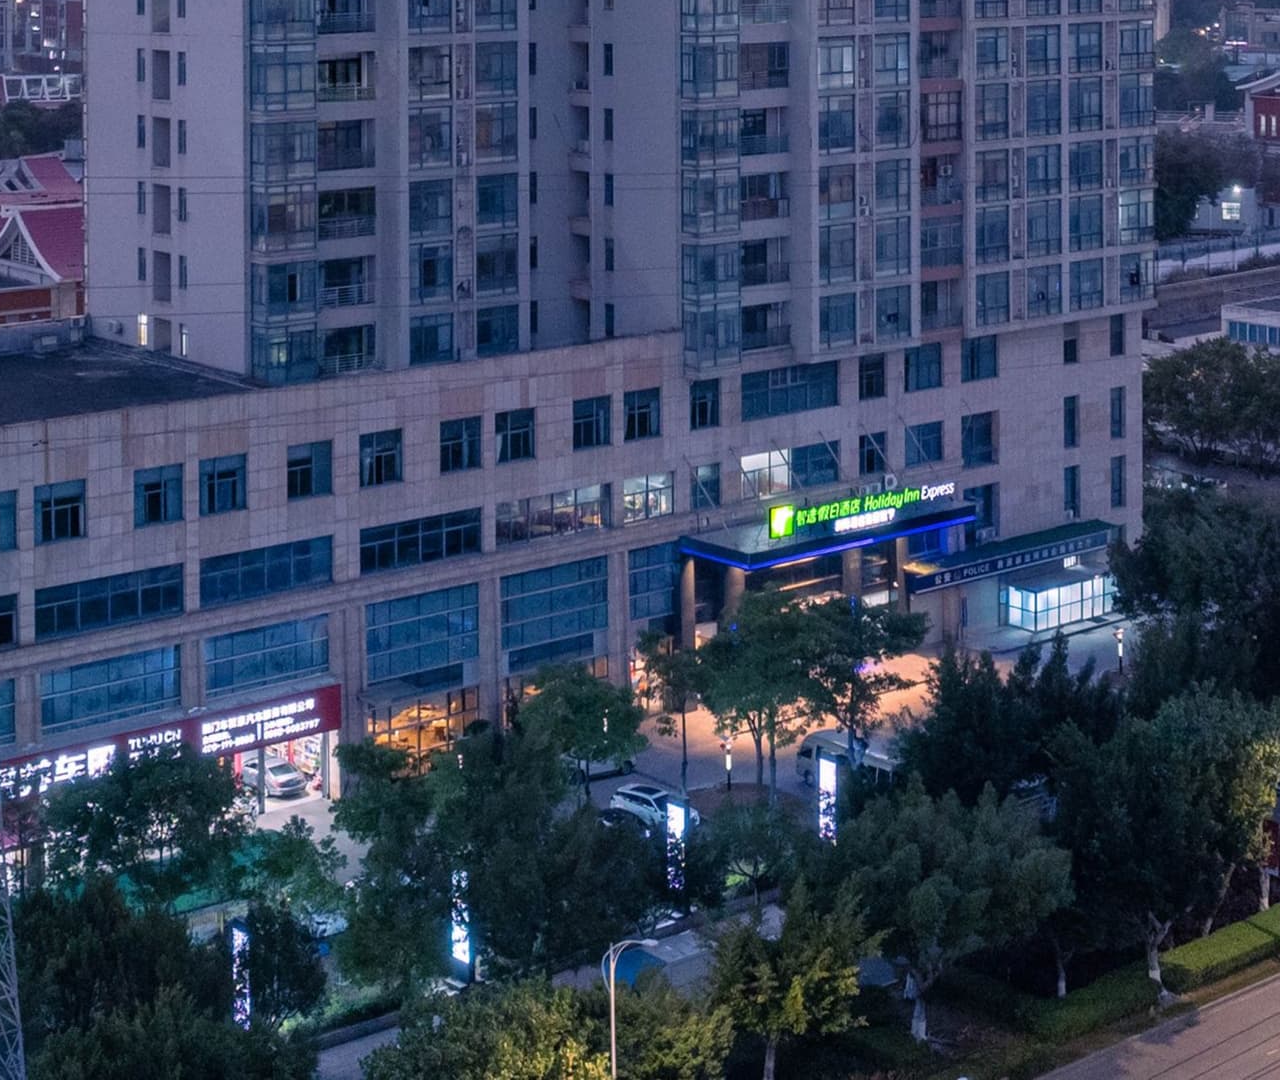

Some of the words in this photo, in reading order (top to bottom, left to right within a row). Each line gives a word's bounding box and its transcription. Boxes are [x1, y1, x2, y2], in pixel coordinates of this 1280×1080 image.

[864, 491, 904, 511] Holiday
[904, 488, 920, 503] Inn
[921, 482, 955, 501] Express
[963, 563, 990, 577] POLICE
